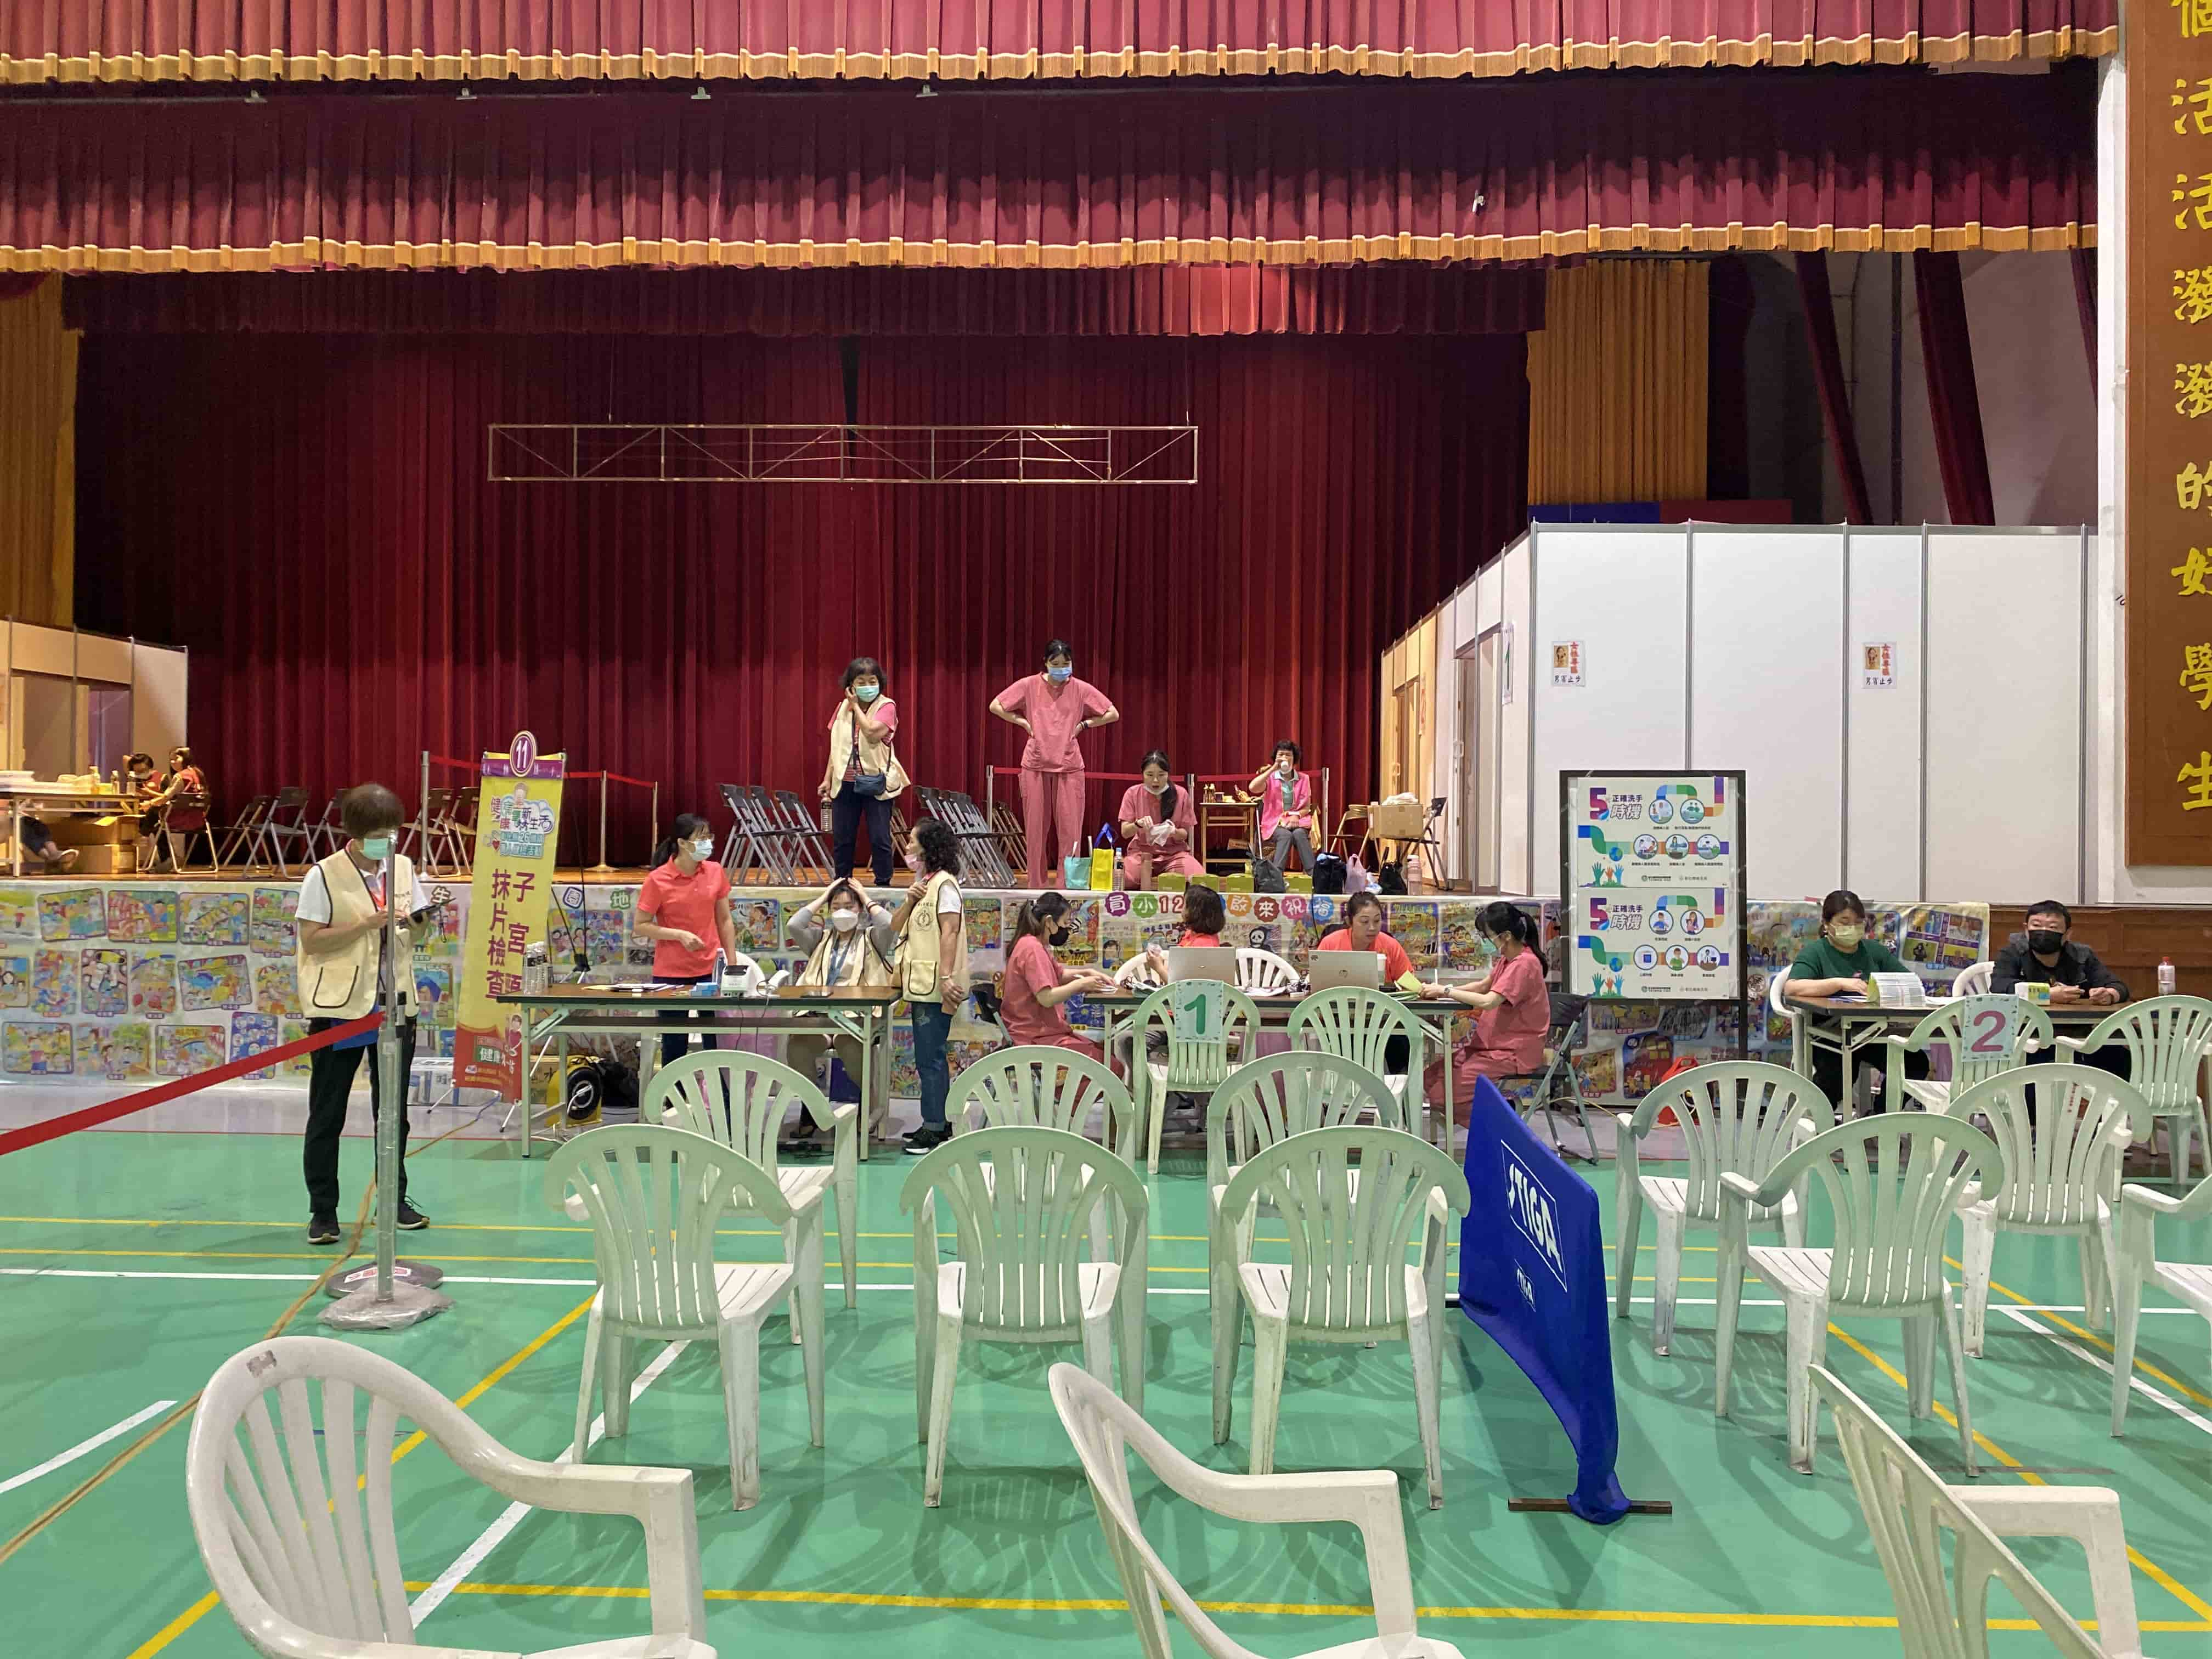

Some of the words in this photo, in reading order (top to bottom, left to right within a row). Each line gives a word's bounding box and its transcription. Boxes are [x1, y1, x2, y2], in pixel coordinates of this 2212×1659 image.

[515, 742, 529, 769] 11
[1589, 787, 1610, 820] 5
[1610, 804, 1642, 820] 時機
[504, 871, 535, 994] 子宮頸
[1590, 898, 1610, 930] 5
[1610, 914, 1642, 930] 時機
[485, 868, 511, 1000] 抹片檢查
[1184, 994, 1206, 1035] 1
[1971, 1010, 2006, 1052] 2
[1508, 1163, 1563, 1273] STIGA
